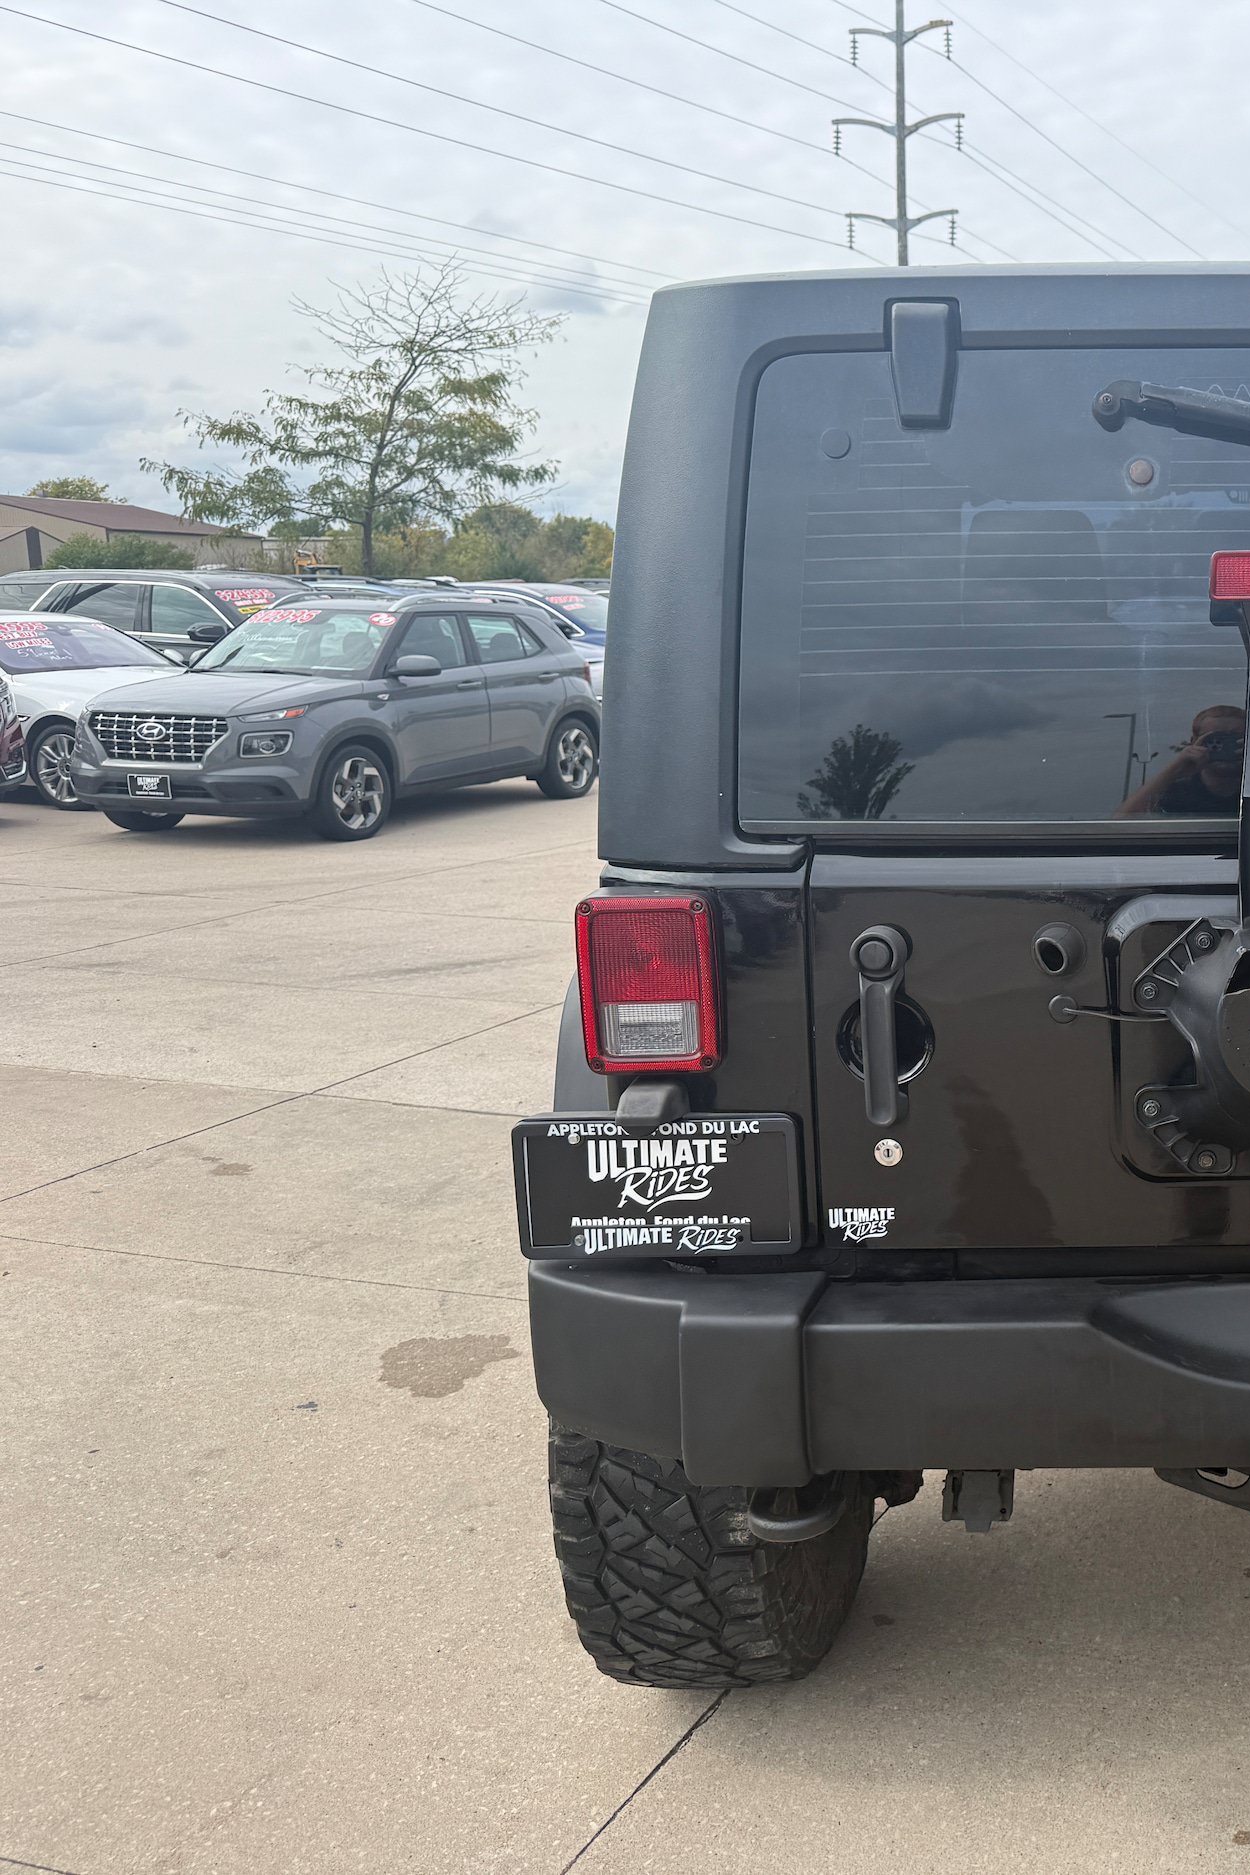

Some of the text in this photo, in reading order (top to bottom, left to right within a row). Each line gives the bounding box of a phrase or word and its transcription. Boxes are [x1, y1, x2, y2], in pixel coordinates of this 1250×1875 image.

[652, 1122, 698, 1136] OND
[702, 1121, 726, 1134] DU
[730, 1121, 760, 1134] LAC
[587, 1139, 728, 1182] ULTIMATE
[828, 1207, 895, 1229] ULTIMATE
[583, 1227, 673, 1255] ULTIMATE
